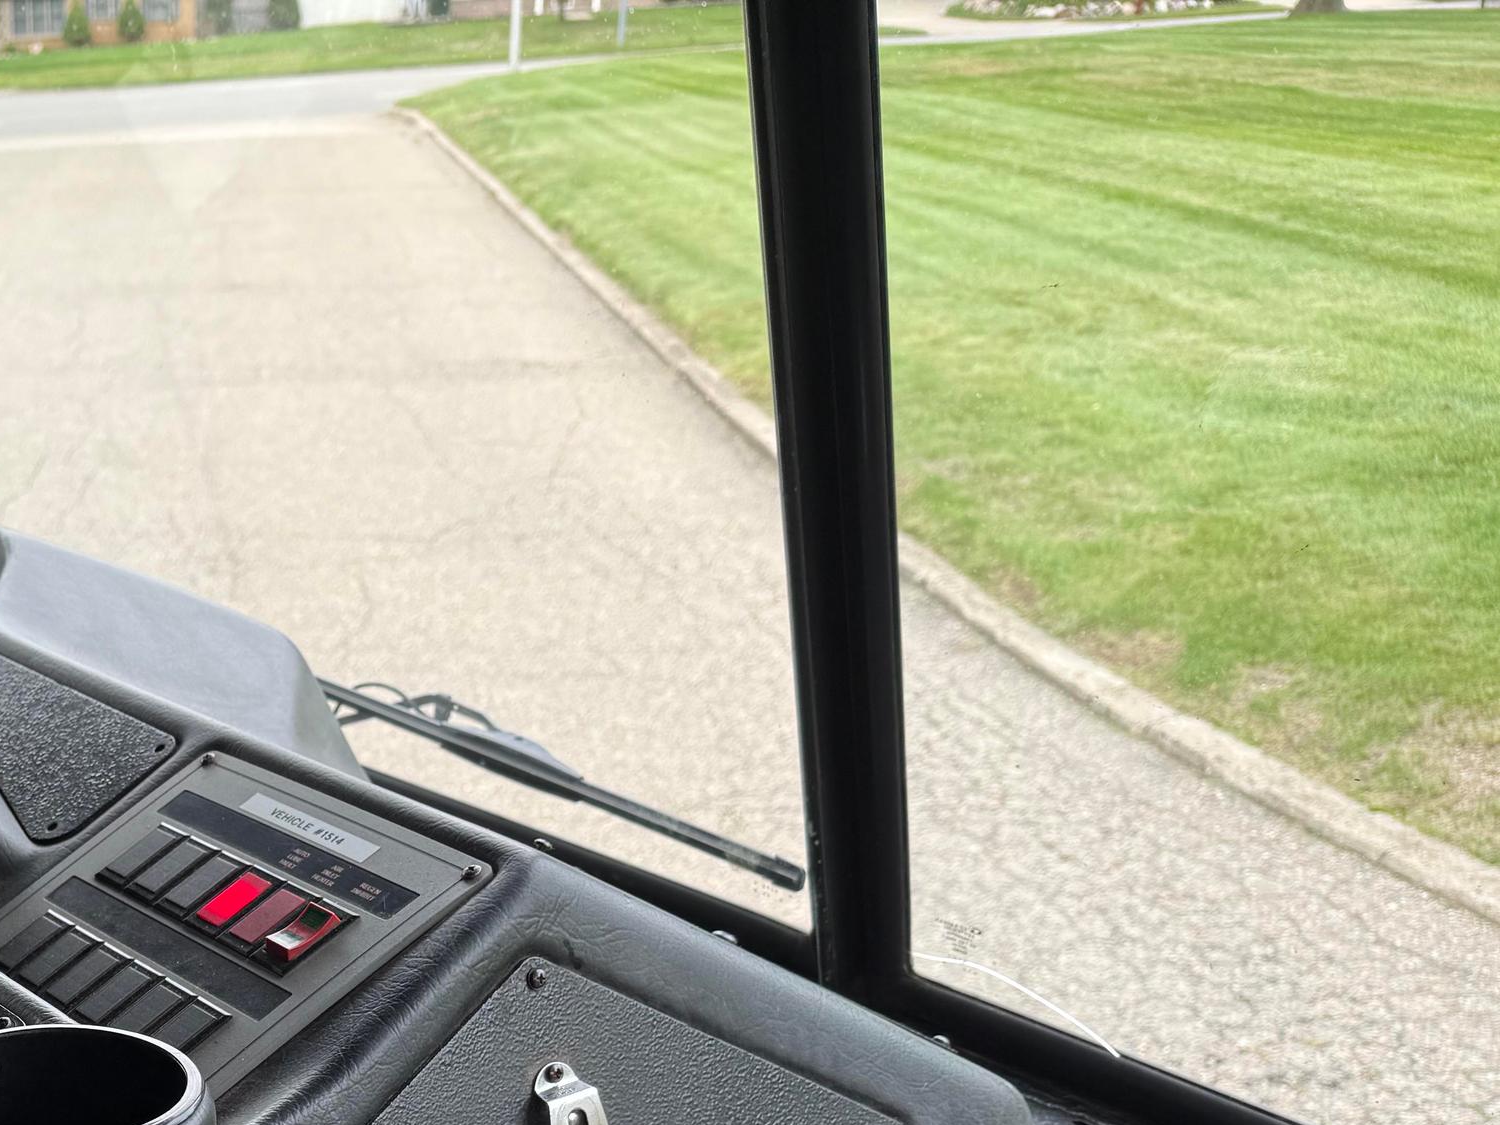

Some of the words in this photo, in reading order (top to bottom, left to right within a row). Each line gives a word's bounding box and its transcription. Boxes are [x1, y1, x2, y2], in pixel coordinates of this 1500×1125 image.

[270, 808, 314, 832] VEHICLE
[313, 828, 345, 846] #1514
[359, 882, 382, 896] REGEN
